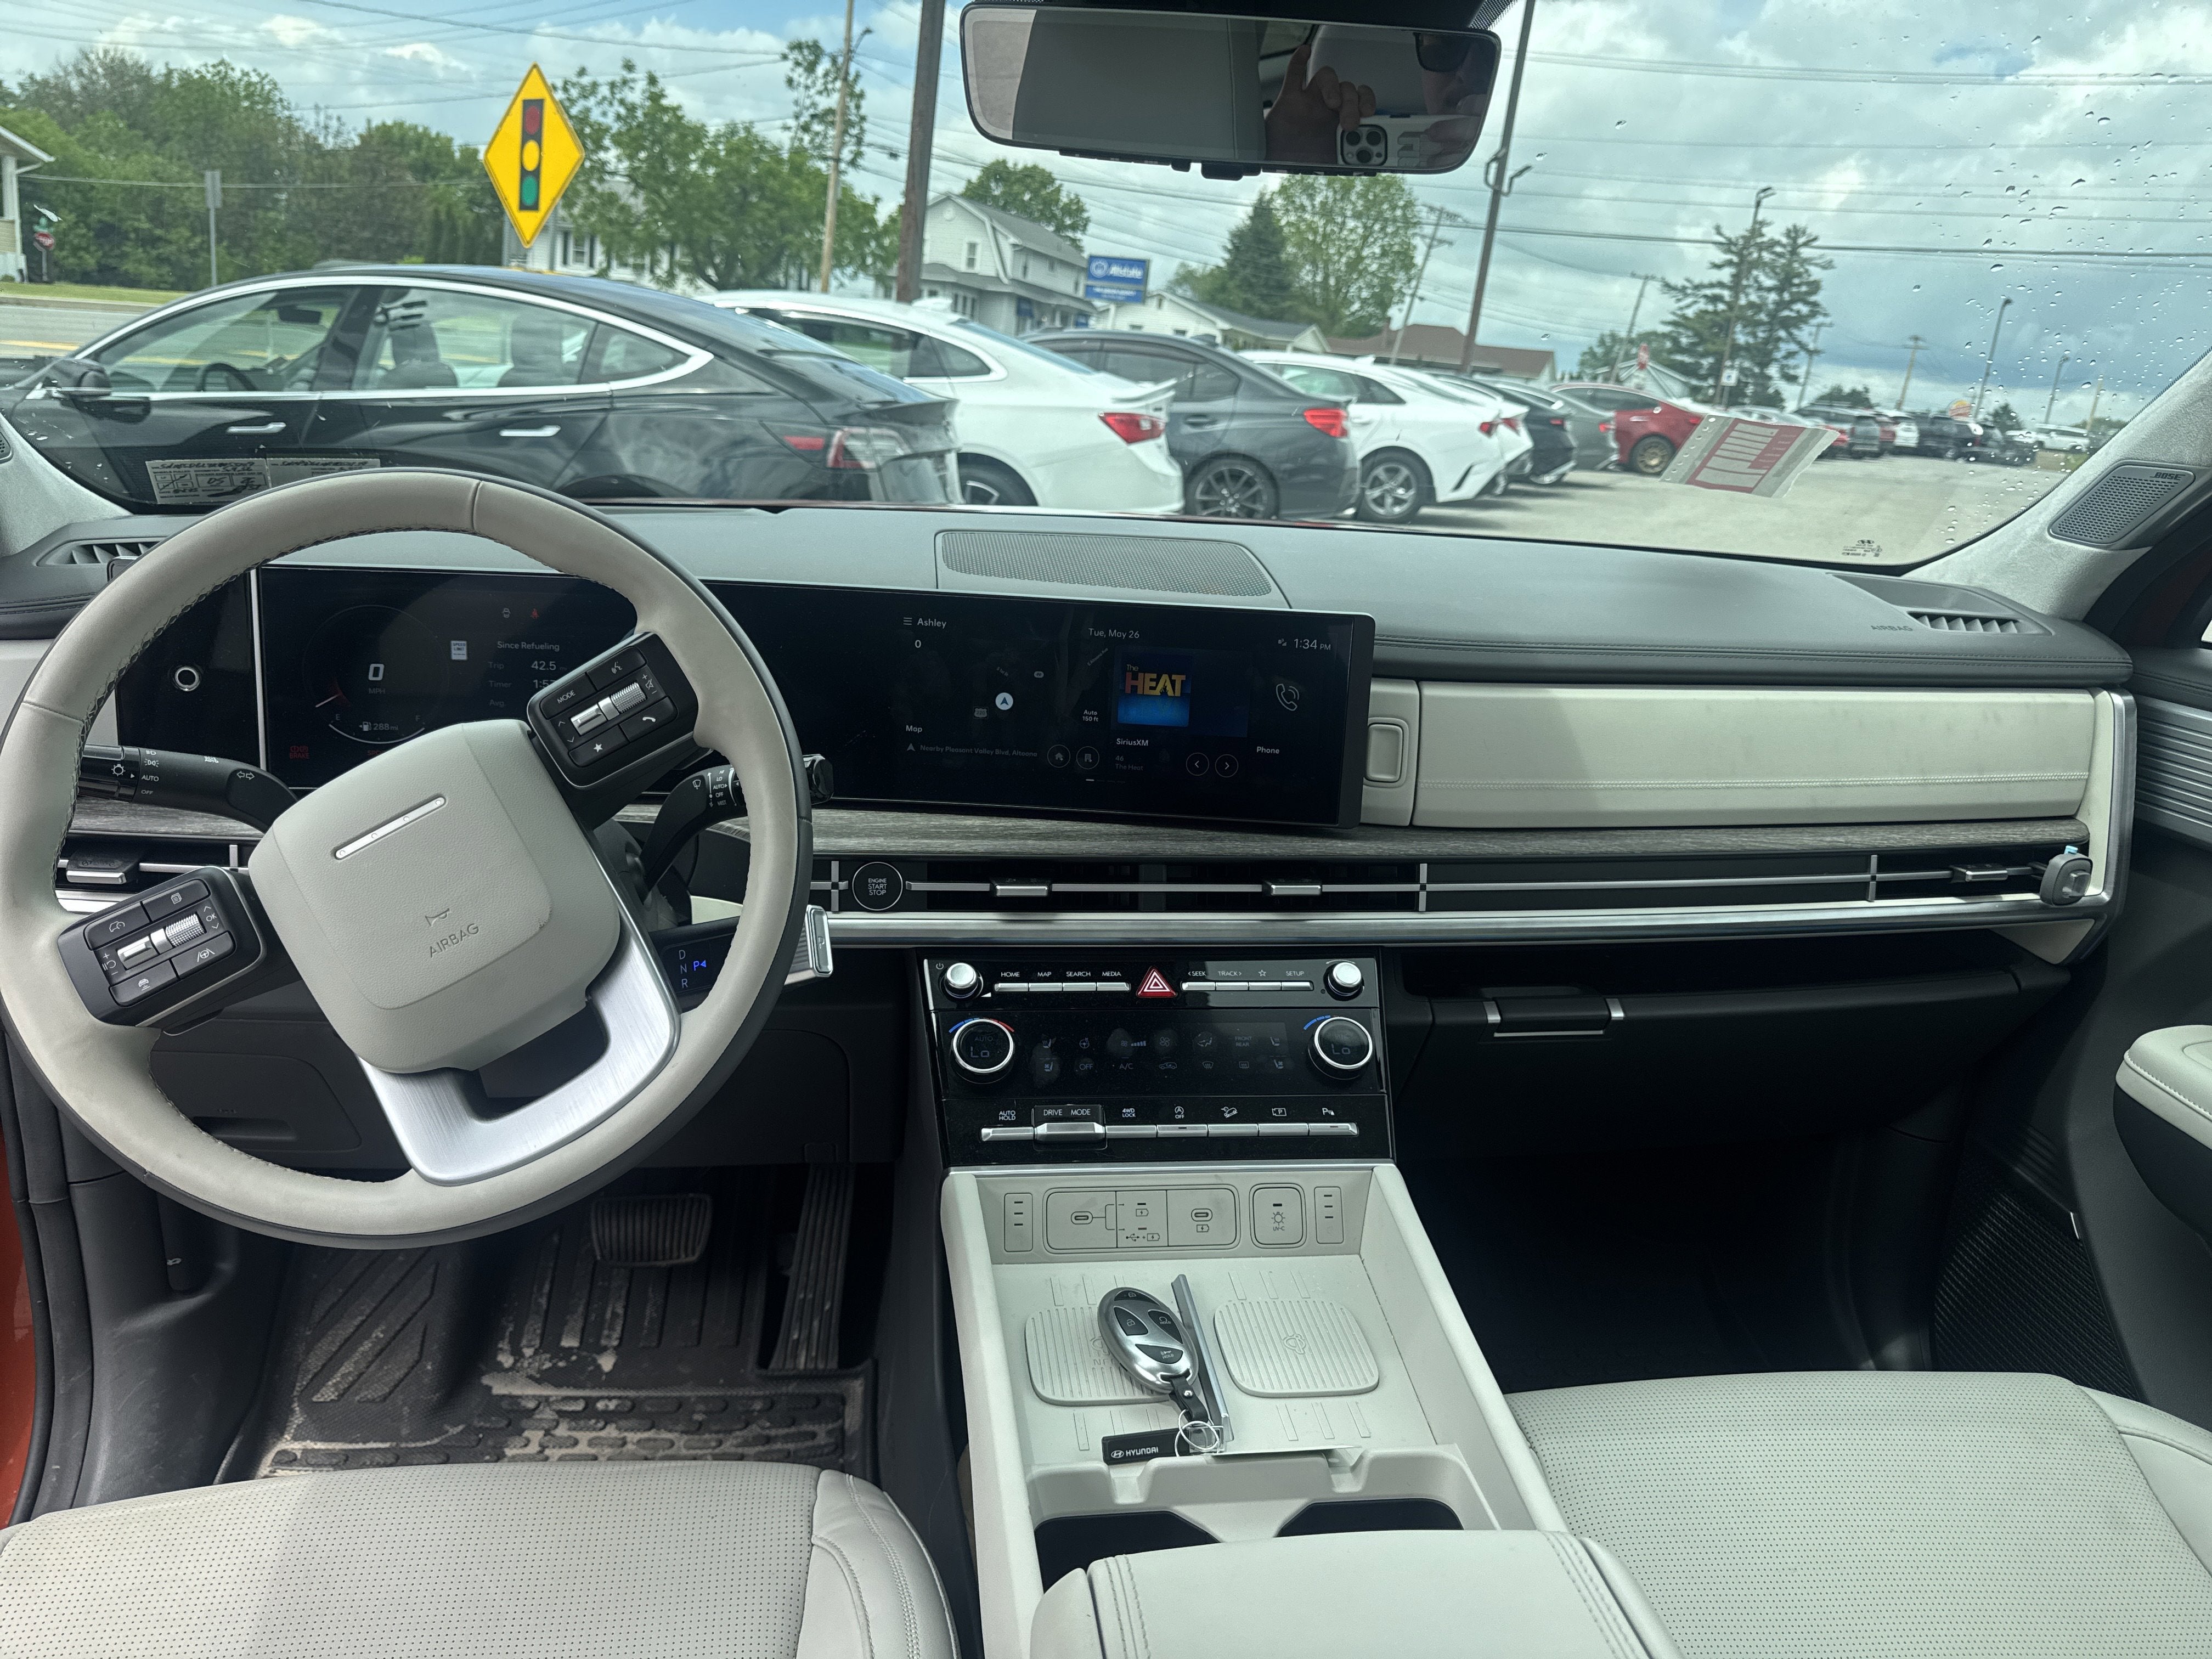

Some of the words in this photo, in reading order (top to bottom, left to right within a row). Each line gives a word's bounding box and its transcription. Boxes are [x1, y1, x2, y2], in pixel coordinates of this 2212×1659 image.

[917, 618, 947, 629] Ashley
[1088, 628, 1106, 638] Tue,
[1109, 629, 1127, 639] May
[1128, 630, 1140, 639] 26
[497, 641, 520, 649] Since
[521, 641, 560, 652] Refueling
[1294, 639, 1317, 650] 1:34
[487, 661, 504, 670] Trip
[531, 661, 556, 670] 42.5
[368, 663, 385, 681] 0
[1125, 672, 1186, 696] HEAT
[557, 690, 575, 704] MODE
[906, 725, 923, 734] Map
[1116, 738, 1149, 746] SiriusXM
[920, 744, 944, 753] Nearby
[974, 747, 994, 756] Valley
[206, 912, 218, 922] OK
[429, 923, 480, 958] AIRBAG
[679, 950, 686, 960] D
[680, 963, 687, 974] N
[693, 961, 699, 971] P
[681, 978, 689, 988] R
[1126, 1446, 1159, 1457] HYUNDAI
